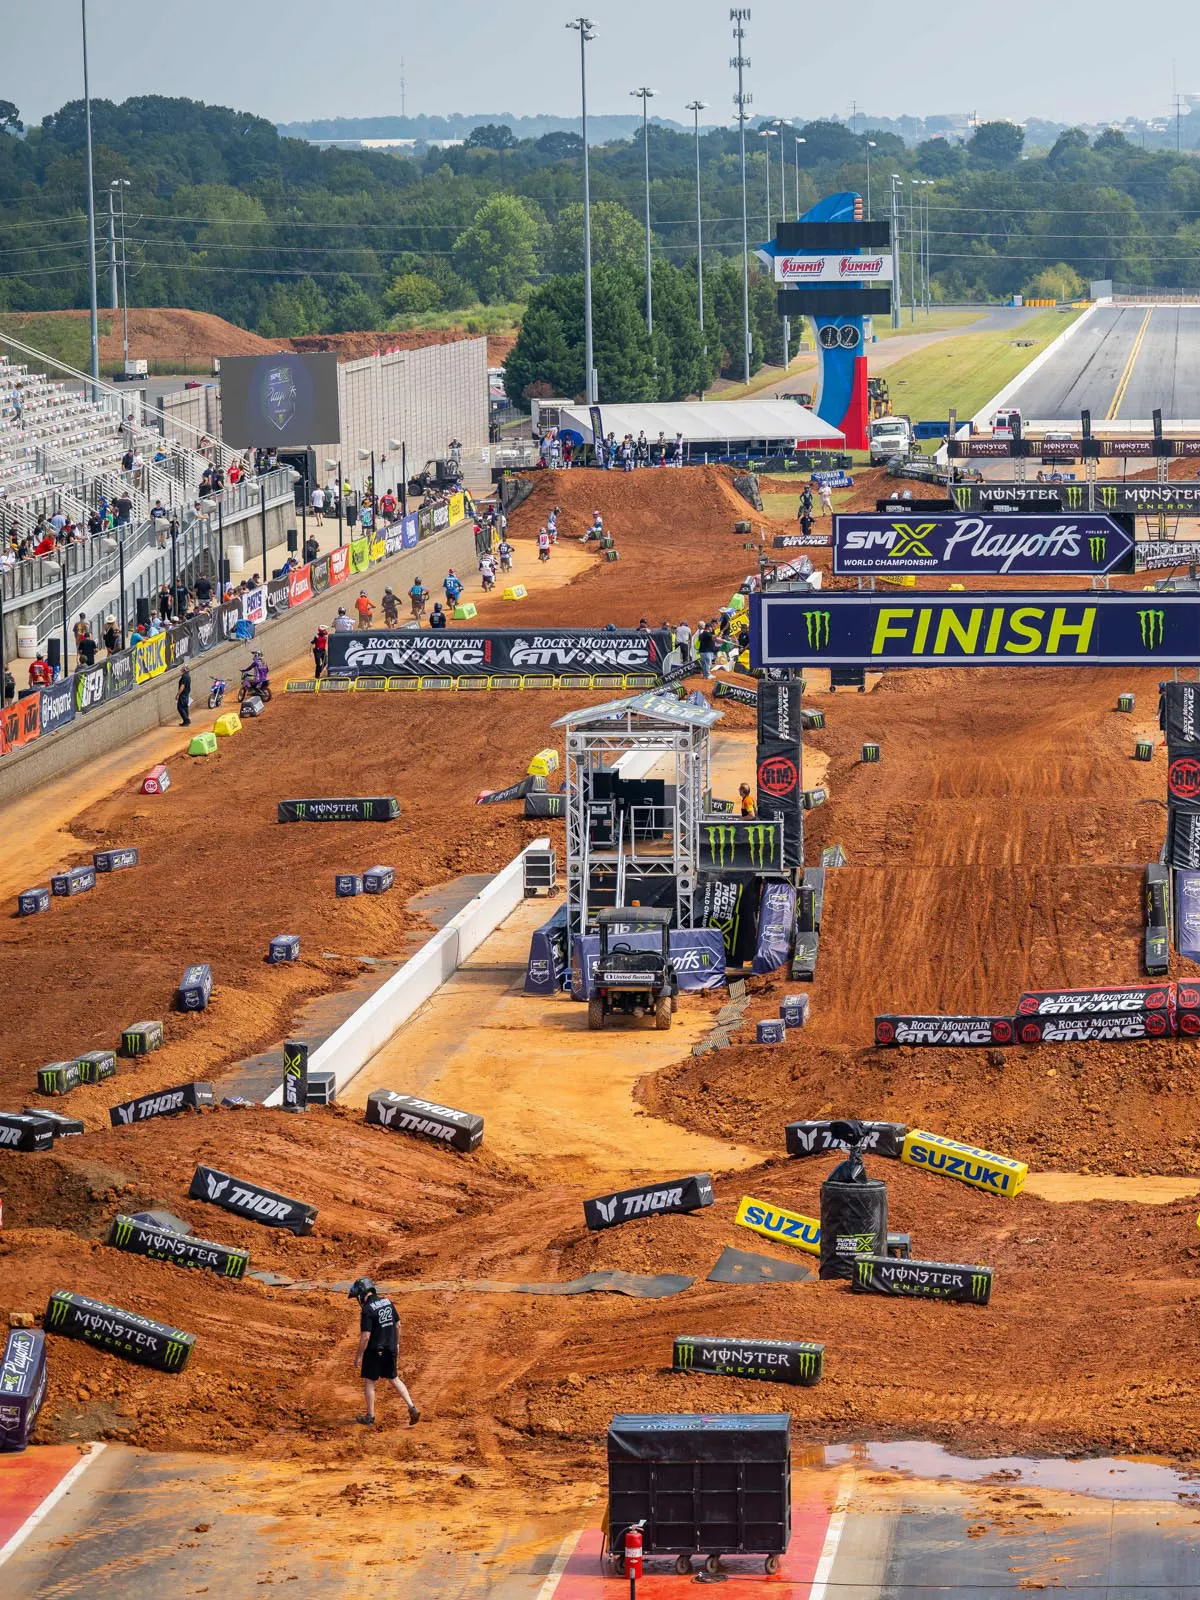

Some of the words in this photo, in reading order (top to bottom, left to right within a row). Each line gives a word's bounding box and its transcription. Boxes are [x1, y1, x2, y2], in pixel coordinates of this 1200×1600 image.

[781, 257, 825, 278] SUMMIT
[839, 256, 883, 278] SUMMIT
[979, 489, 1059, 500] MONSTER
[843, 523, 937, 557] SMX
[943, 518, 1082, 573] Playoffs
[367, 637, 411, 649] ROCKY
[413, 637, 484, 649] MOUNTAIN
[533, 637, 576, 649] ROCKY
[578, 637, 649, 648] MOUNTAIN
[871, 607, 1097, 654] FINISH
[310, 803, 359, 813] MONSTER
[712, 881, 722, 919] CROSS
[719, 884, 730, 919] MOTO
[726, 883, 737, 920] SUPER
[1056, 994, 1089, 1004] ROCKY
[1090, 992, 1146, 1002] MOUNTAIN
[909, 1021, 940, 1030] ROCKY
[941, 1021, 990, 1031] MOUNTAIN
[1058, 1019, 1089, 1029] ROCKY
[1091, 1016, 1144, 1027] MOUNTAIN
[284, 1052, 301, 1104] SMX
[138, 1092, 185, 1118] THOR
[414, 1097, 469, 1121] THOR
[400, 1113, 457, 1142] THOR
[917, 1132, 1018, 1168] SUZUKI
[908, 1145, 1010, 1190] SUZUKI
[227, 1185, 294, 1221] THOR
[622, 1187, 683, 1216] THOR
[744, 1205, 820, 1245] SUZU
[138, 1230, 219, 1265] MONSTER
[881, 1267, 964, 1288] MONSTER
[893, 1282, 951, 1295] ENERGY
[378, 1306, 393, 1324] 22
[74, 1311, 158, 1350] MONSTER
[84, 1329, 143, 1355] ENERGY
[4, 1339, 34, 1376] Playoffs
[702, 1348, 790, 1367] MONSTER
[716, 1365, 777, 1375] ENERGY
